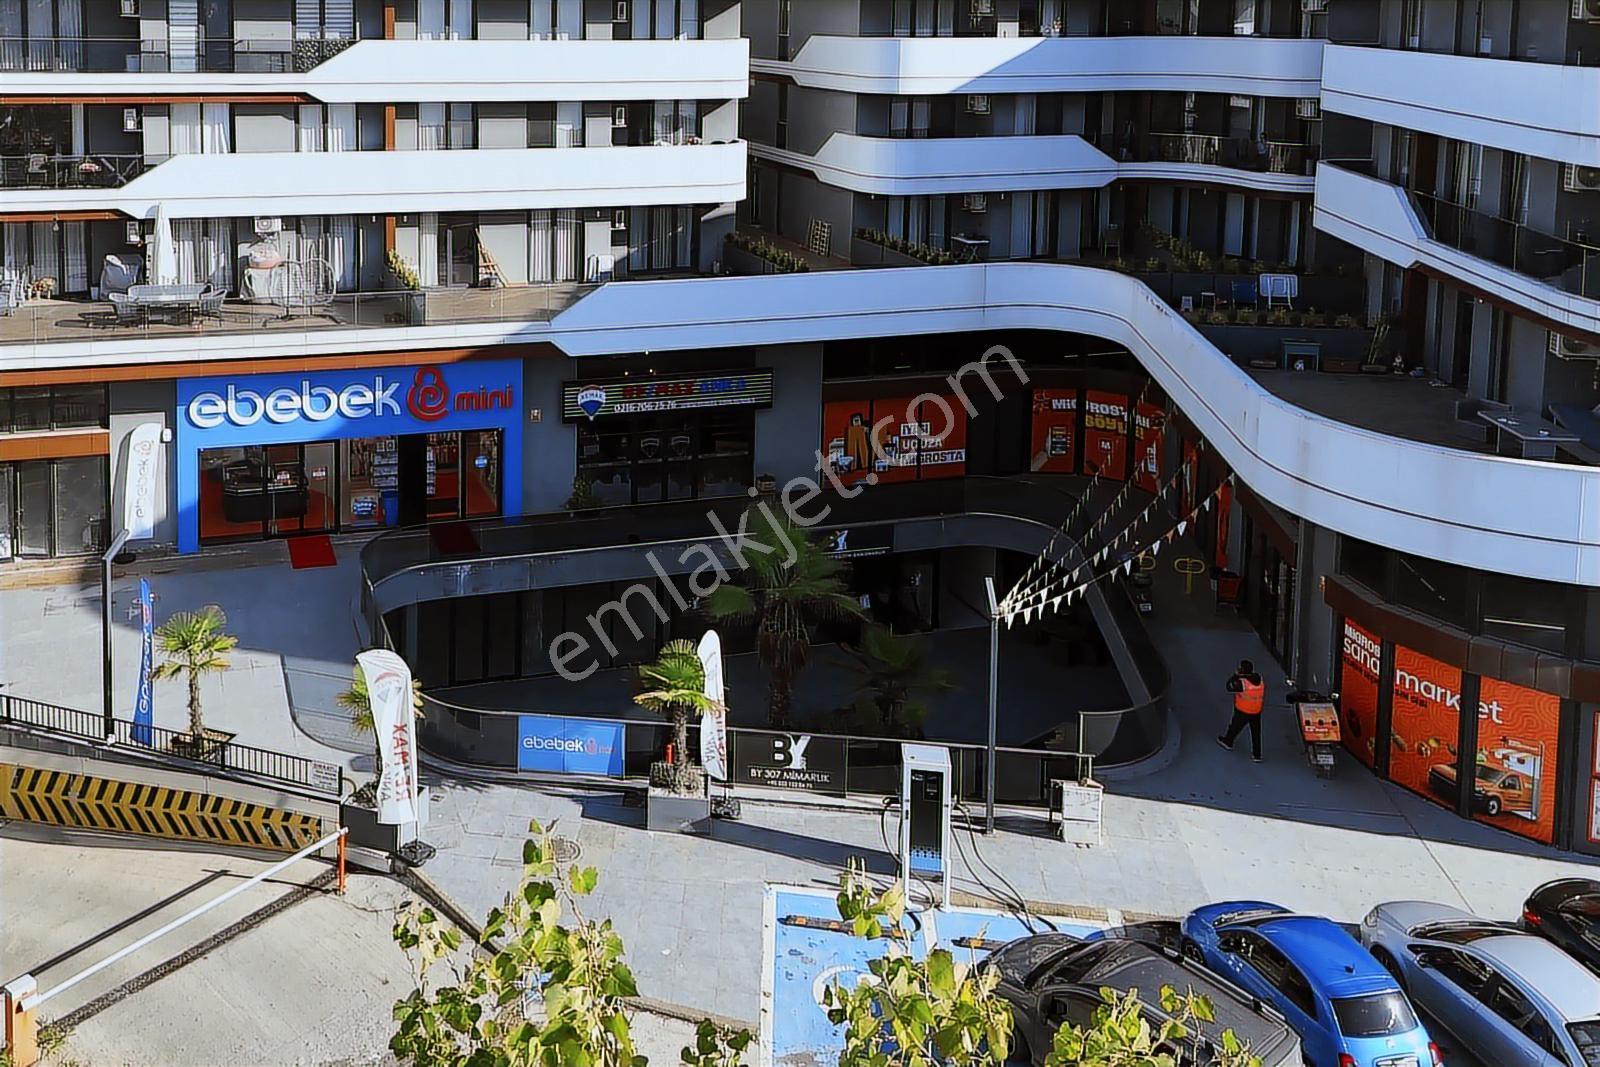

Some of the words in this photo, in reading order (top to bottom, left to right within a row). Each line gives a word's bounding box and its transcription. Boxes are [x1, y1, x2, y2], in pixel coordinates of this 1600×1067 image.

[188, 376, 401, 428] ebebek
[454, 384, 513, 411] mini
[1342, 637, 1381, 676] sana
[1395, 669, 1503, 724] market
[523, 736, 585, 752] ebebek
[750, 768, 763, 778] BY
[764, 769, 781, 779] 307
